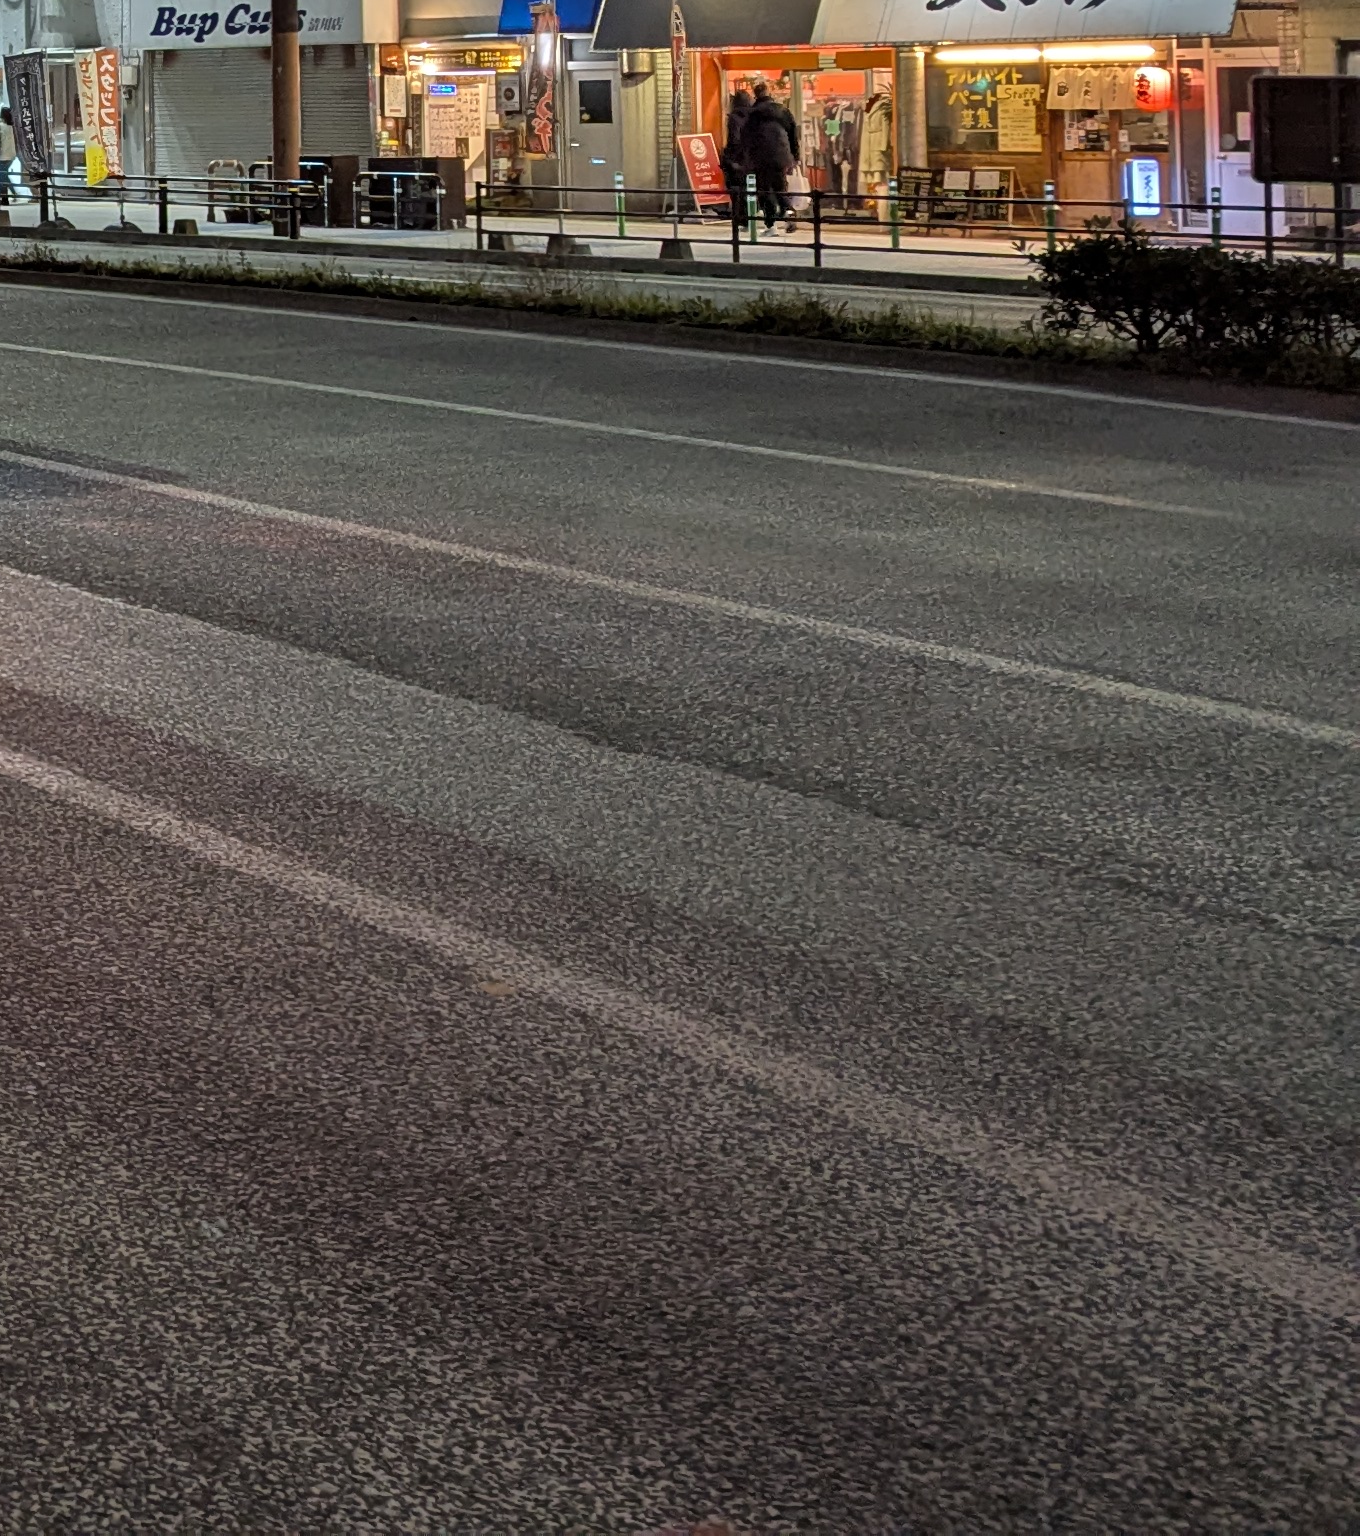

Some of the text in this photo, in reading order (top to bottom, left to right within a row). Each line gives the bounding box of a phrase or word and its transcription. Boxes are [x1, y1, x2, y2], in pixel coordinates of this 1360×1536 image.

[149, 6, 219, 44] Bup
[225, 3, 307, 36] Cus
[946, 67, 1023, 87] アルバイト
[948, 89, 997, 108] パート
[1004, 87, 1036, 100] Staff
[961, 107, 994, 129] 募集
